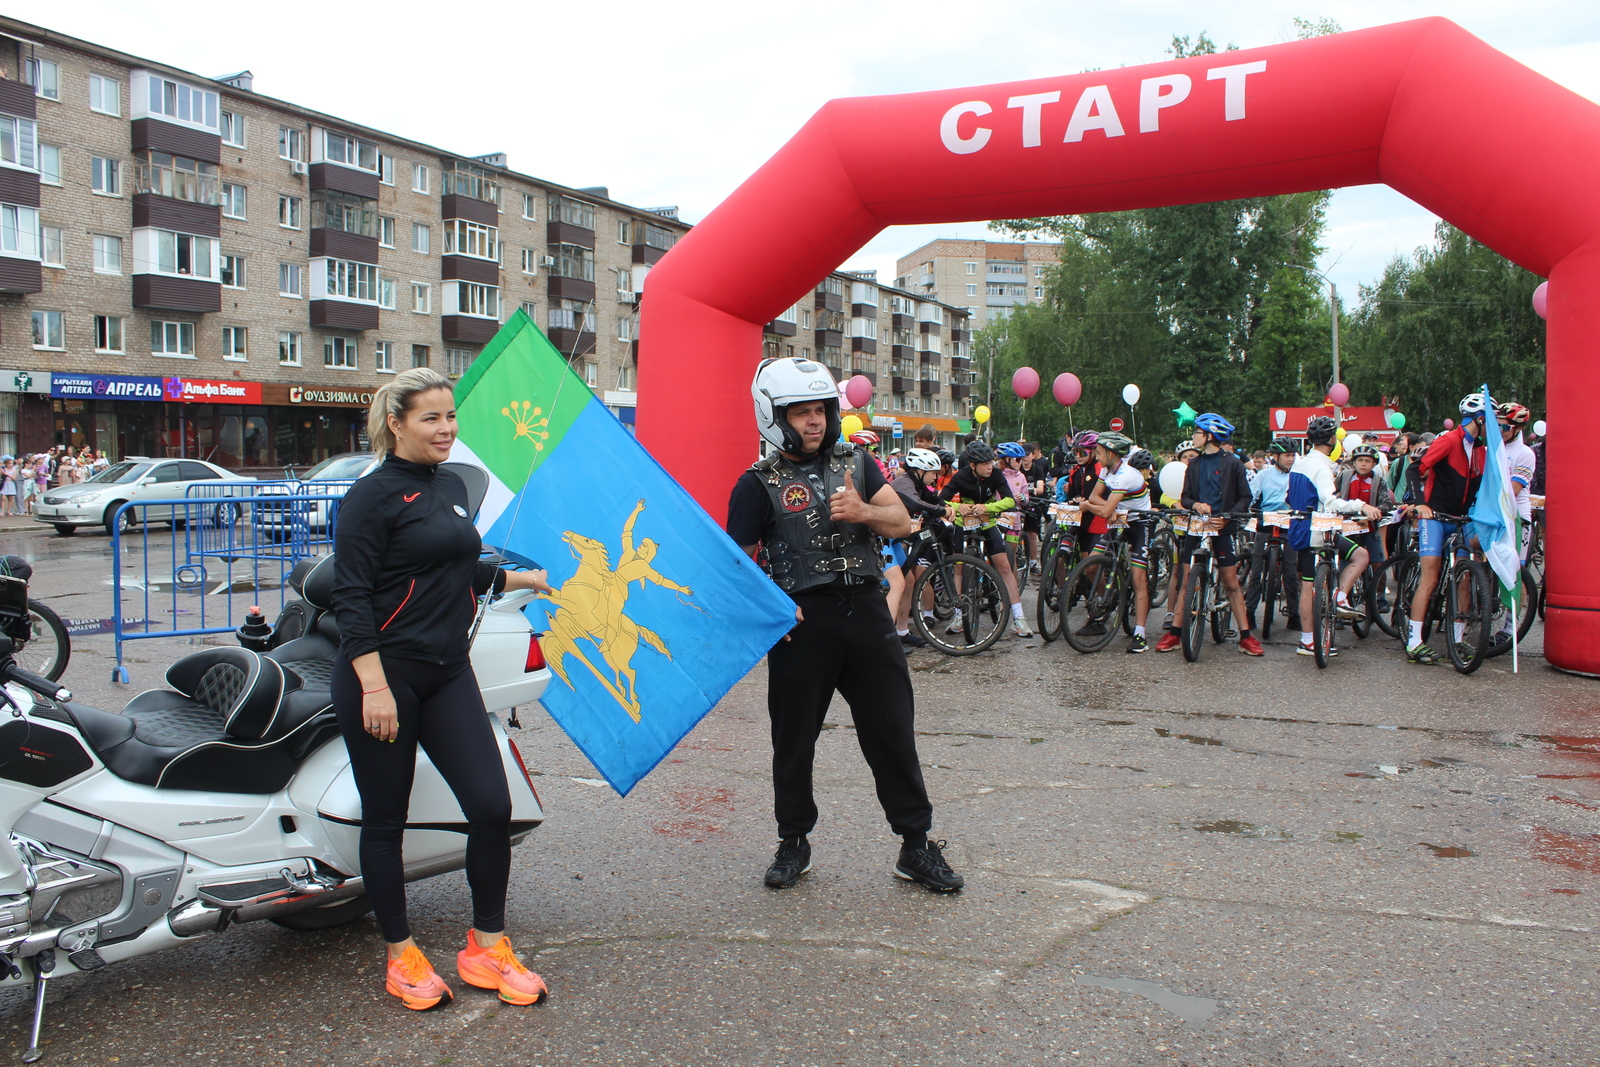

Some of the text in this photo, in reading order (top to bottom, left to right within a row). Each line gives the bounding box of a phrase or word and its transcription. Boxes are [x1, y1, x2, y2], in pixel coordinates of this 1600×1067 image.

[939, 60, 1268, 155] СТАРТ
[60, 385, 93, 395] АПТЕКА
[105, 382, 162, 397] АПРЕЛЬ
[184, 382, 246, 398] Альфа Банк
[304, 390, 375, 404] ФУДЗИЯМА СУ
